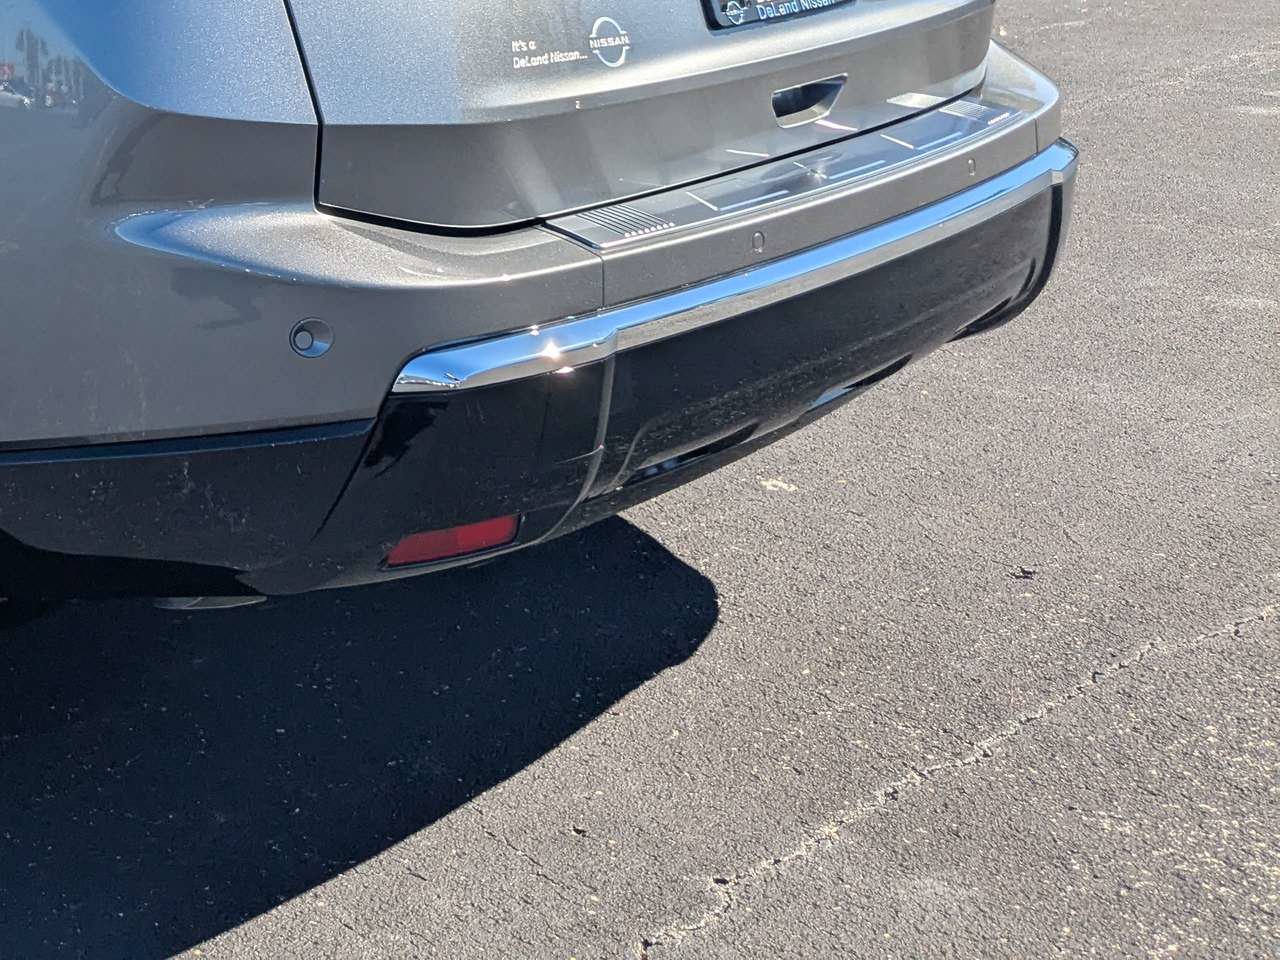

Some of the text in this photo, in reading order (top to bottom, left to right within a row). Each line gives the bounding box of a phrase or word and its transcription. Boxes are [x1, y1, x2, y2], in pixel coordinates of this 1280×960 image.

[511, 40, 537, 53] It's a
[589, 35, 631, 49] NISSAN
[513, 53, 550, 69] DeLand
